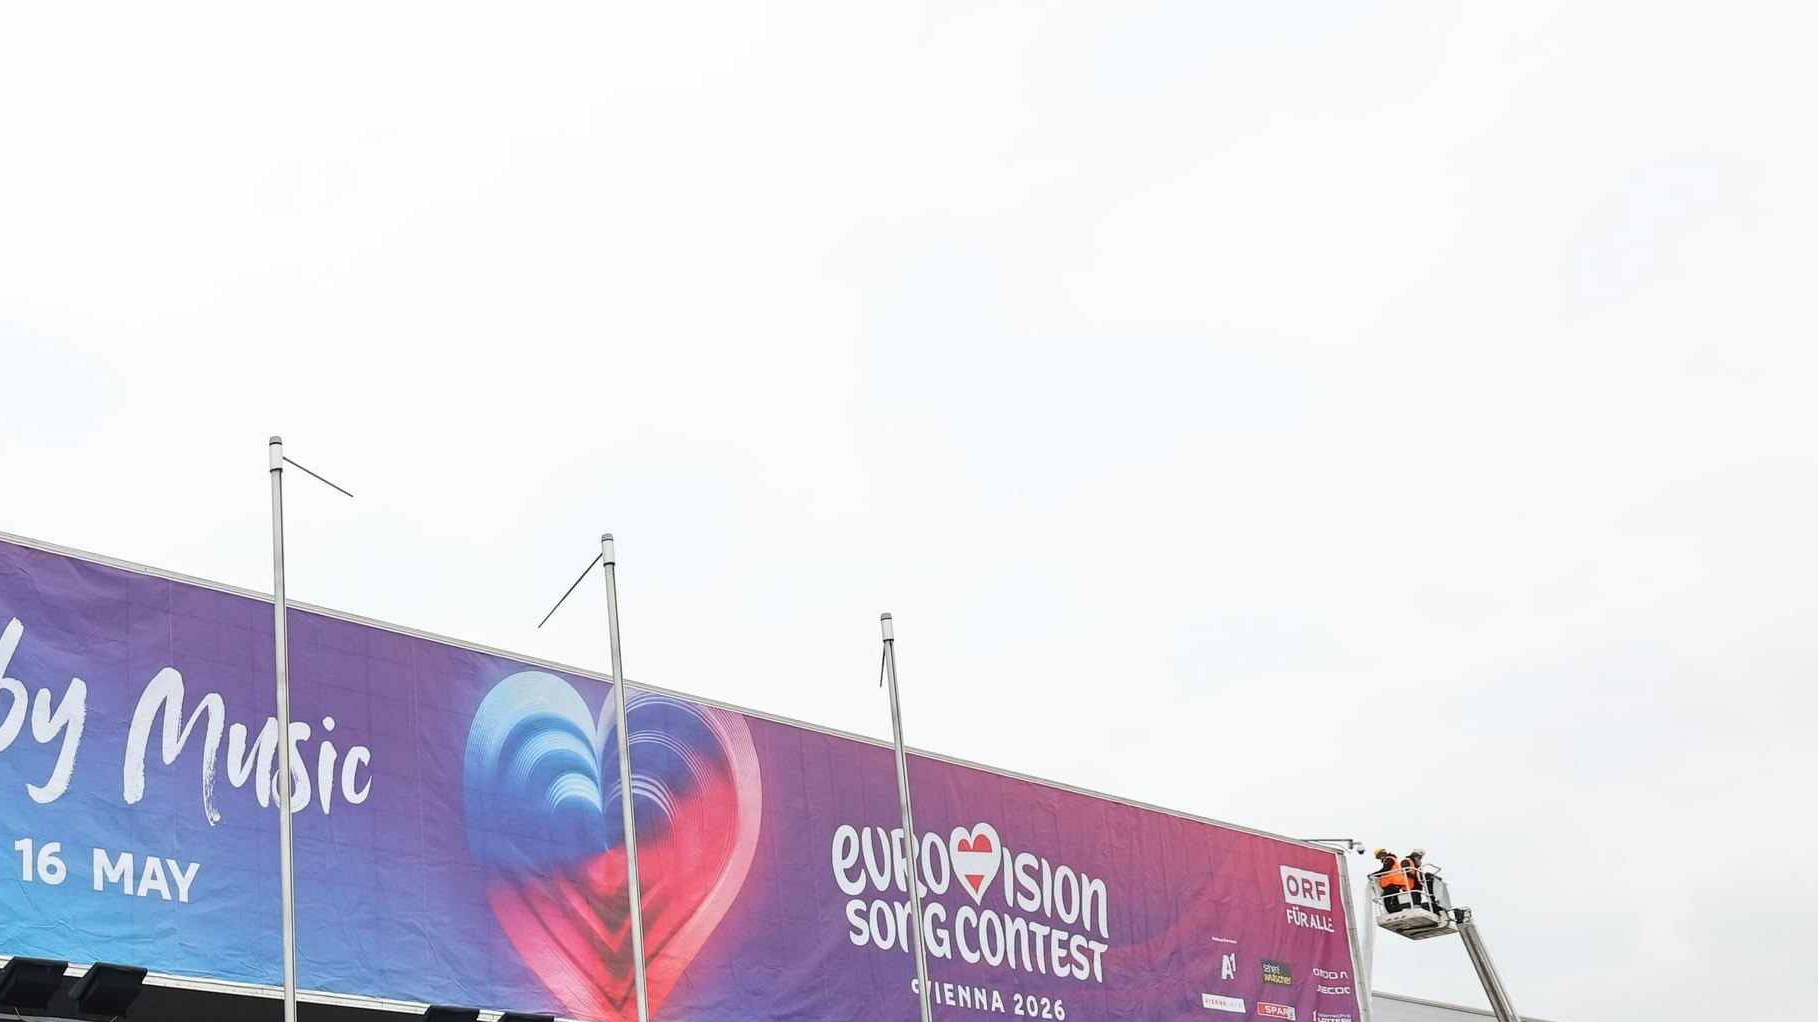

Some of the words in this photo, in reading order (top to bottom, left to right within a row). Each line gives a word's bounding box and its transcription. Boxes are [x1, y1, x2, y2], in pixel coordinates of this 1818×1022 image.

[124, 667, 374, 826] Music
[14, 838, 67, 886] 16
[93, 847, 201, 903] MAY
[1287, 875, 1325, 901] ORF
[1286, 906, 1309, 927] FÜR
[1310, 914, 1335, 932] ALLE
[955, 905, 1109, 983] CONTEST
[1221, 953, 1237, 979] A1
[1014, 993, 1066, 1021] 2026
